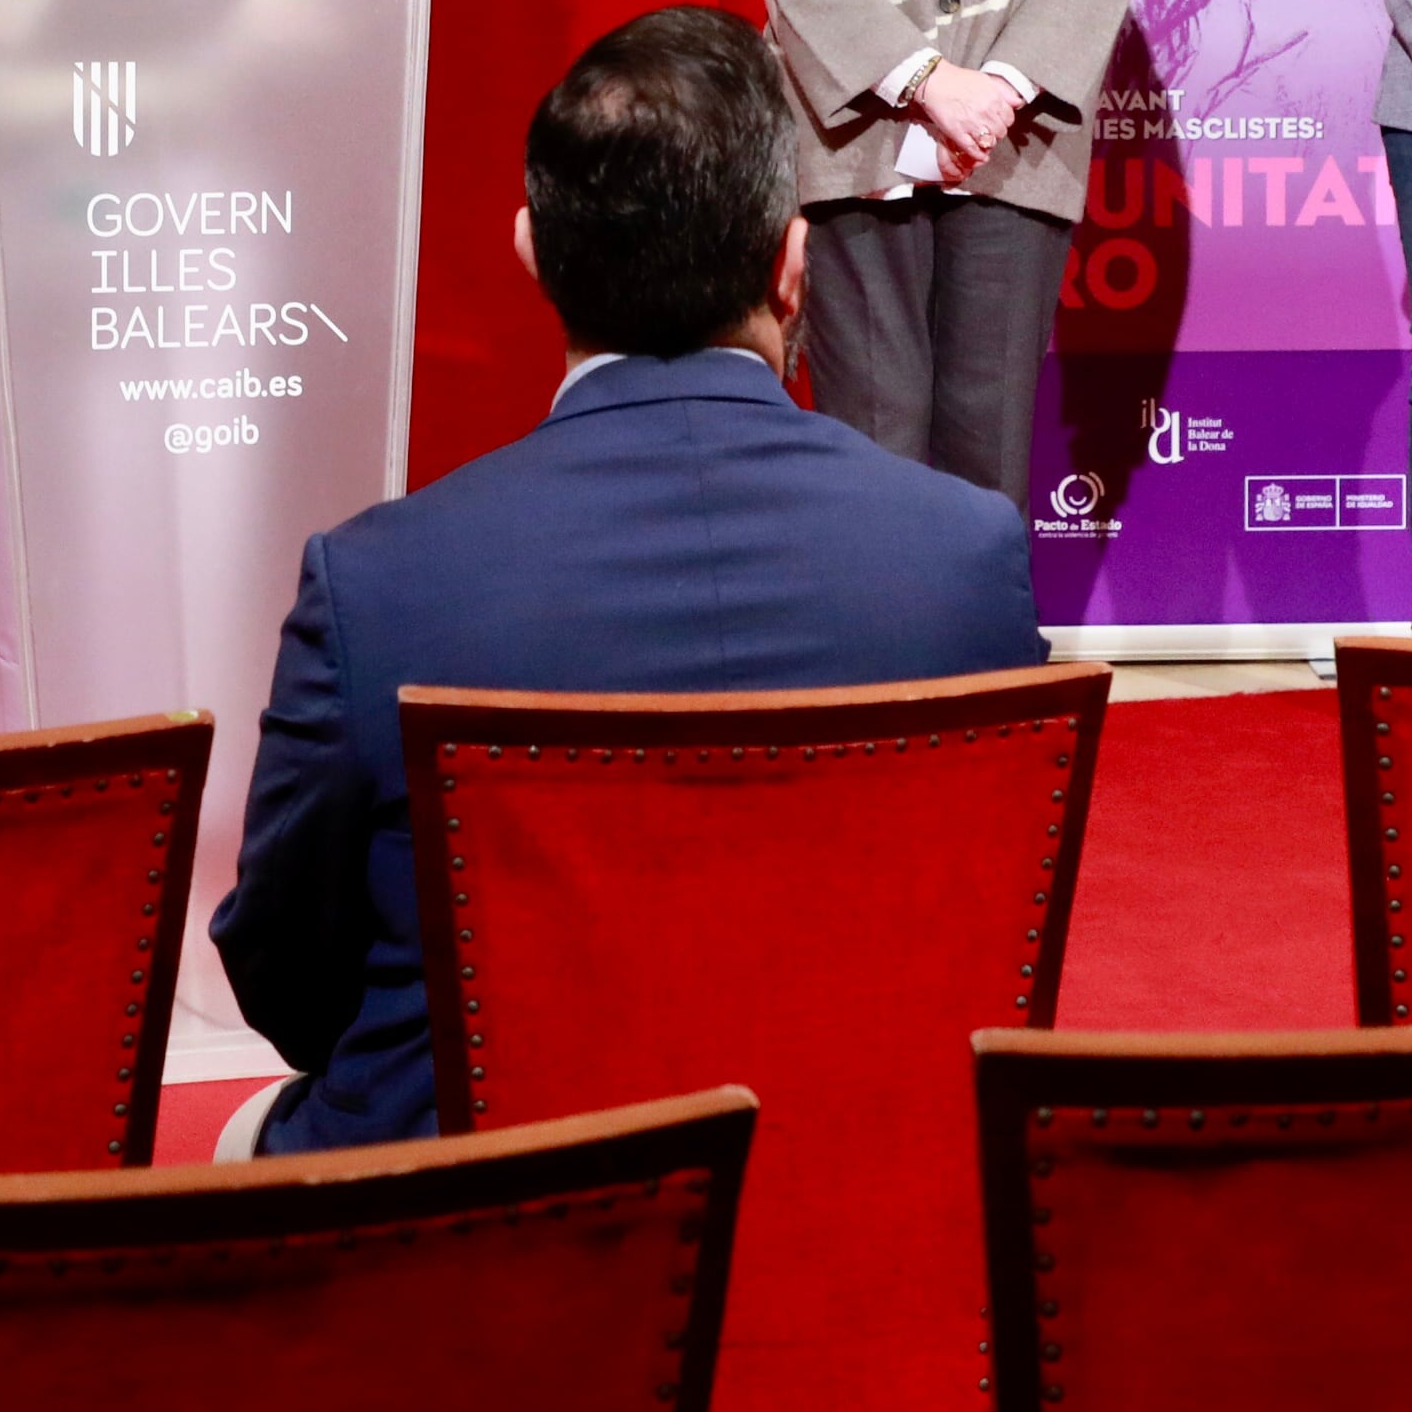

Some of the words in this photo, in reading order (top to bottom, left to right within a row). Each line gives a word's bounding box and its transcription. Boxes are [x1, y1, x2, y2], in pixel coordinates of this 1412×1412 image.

[1144, 116, 1325, 140] MASCLISTES:
[1088, 155, 1396, 229] UNITAT
[86, 191, 292, 236] GOVERN
[91, 248, 236, 293] ILLES
[119, 368, 303, 402] www.caib.es
[164, 414, 260, 453] @goib
[1187, 417, 1222, 428] Institut
[1187, 429, 1220, 439] Balear
[1221, 429, 1234, 439] de
[1187, 441, 1197, 451] la
[1199, 441, 1226, 451] Dona
[1034, 519, 1068, 531] Pacto
[1080, 518, 1122, 531] Estado
